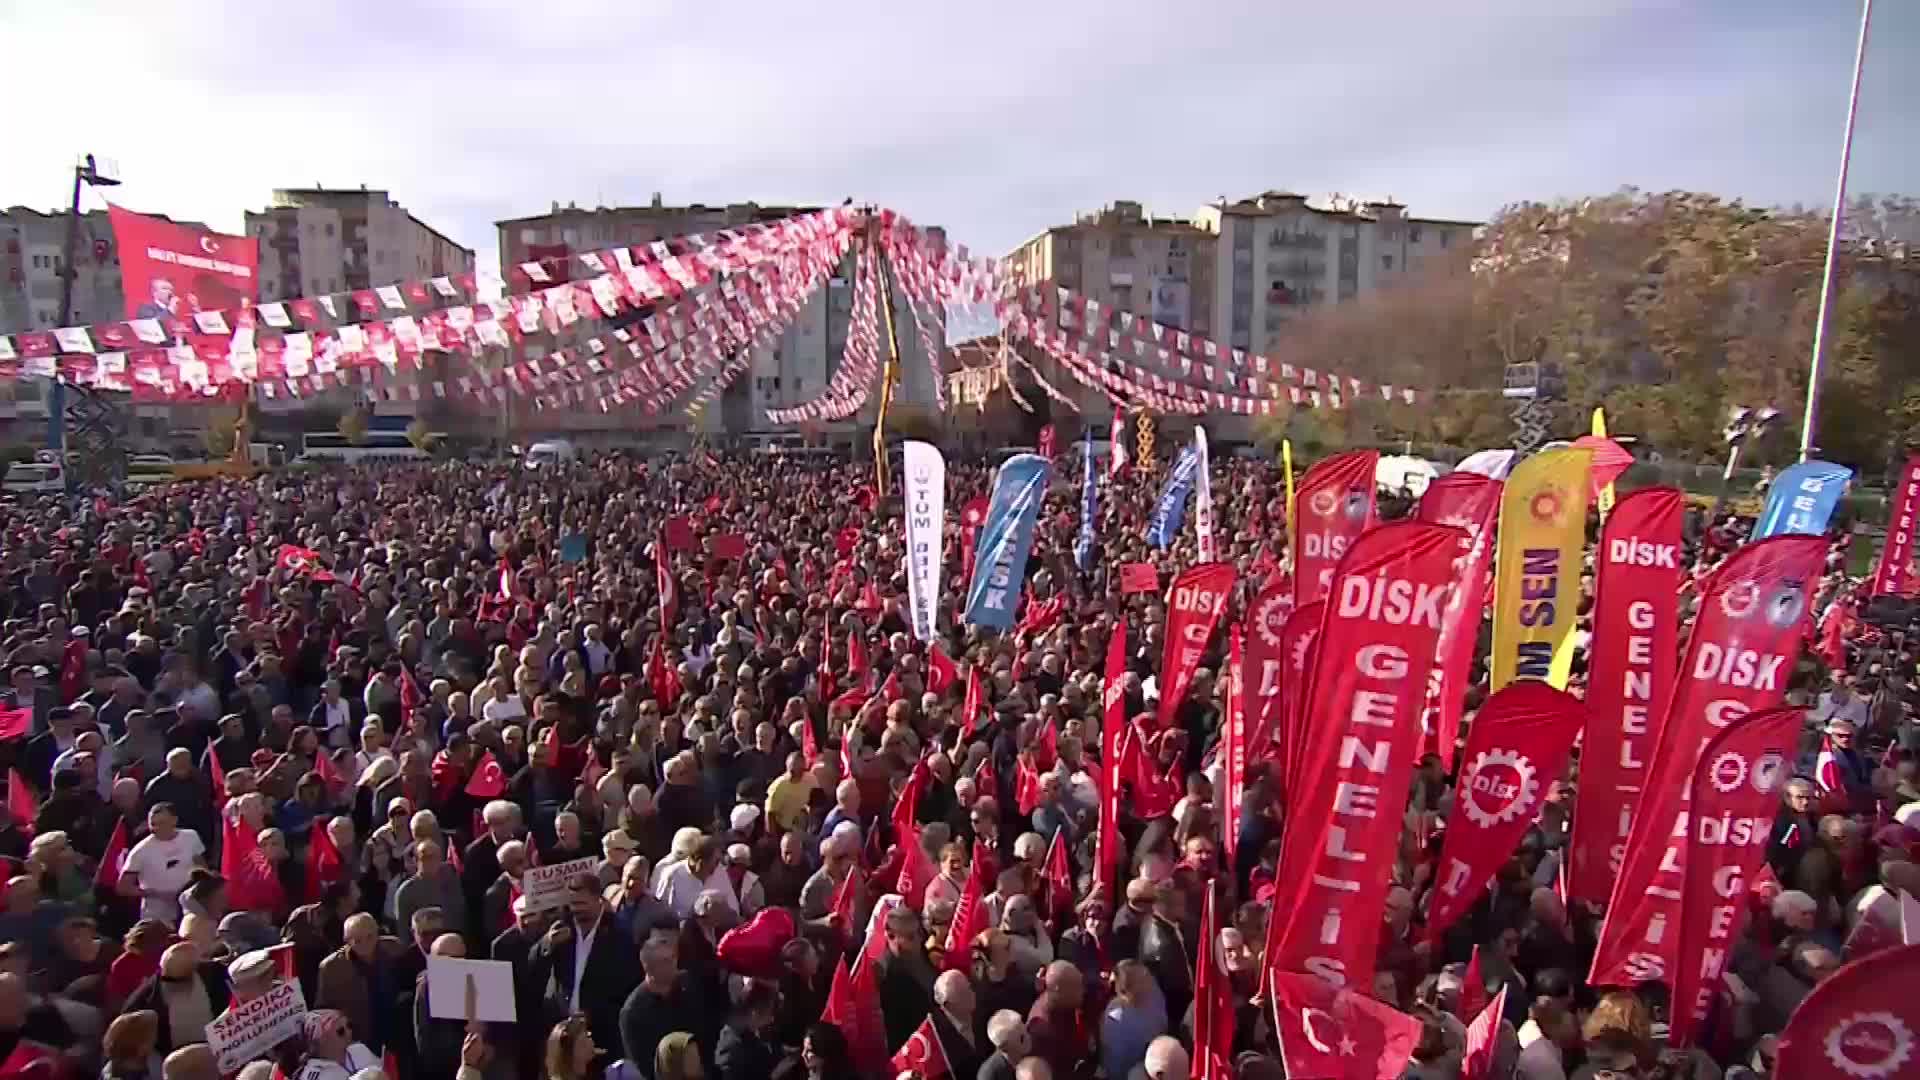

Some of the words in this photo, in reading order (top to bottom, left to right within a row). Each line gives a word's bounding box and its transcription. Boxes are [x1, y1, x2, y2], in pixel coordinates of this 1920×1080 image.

[1303, 529, 1347, 560] DİS
[1610, 536, 1676, 569] DİSK
[1338, 567, 1446, 630] DİSK
[1519, 549, 1560, 627] SEN
[1693, 636, 1785, 691] DİSK
